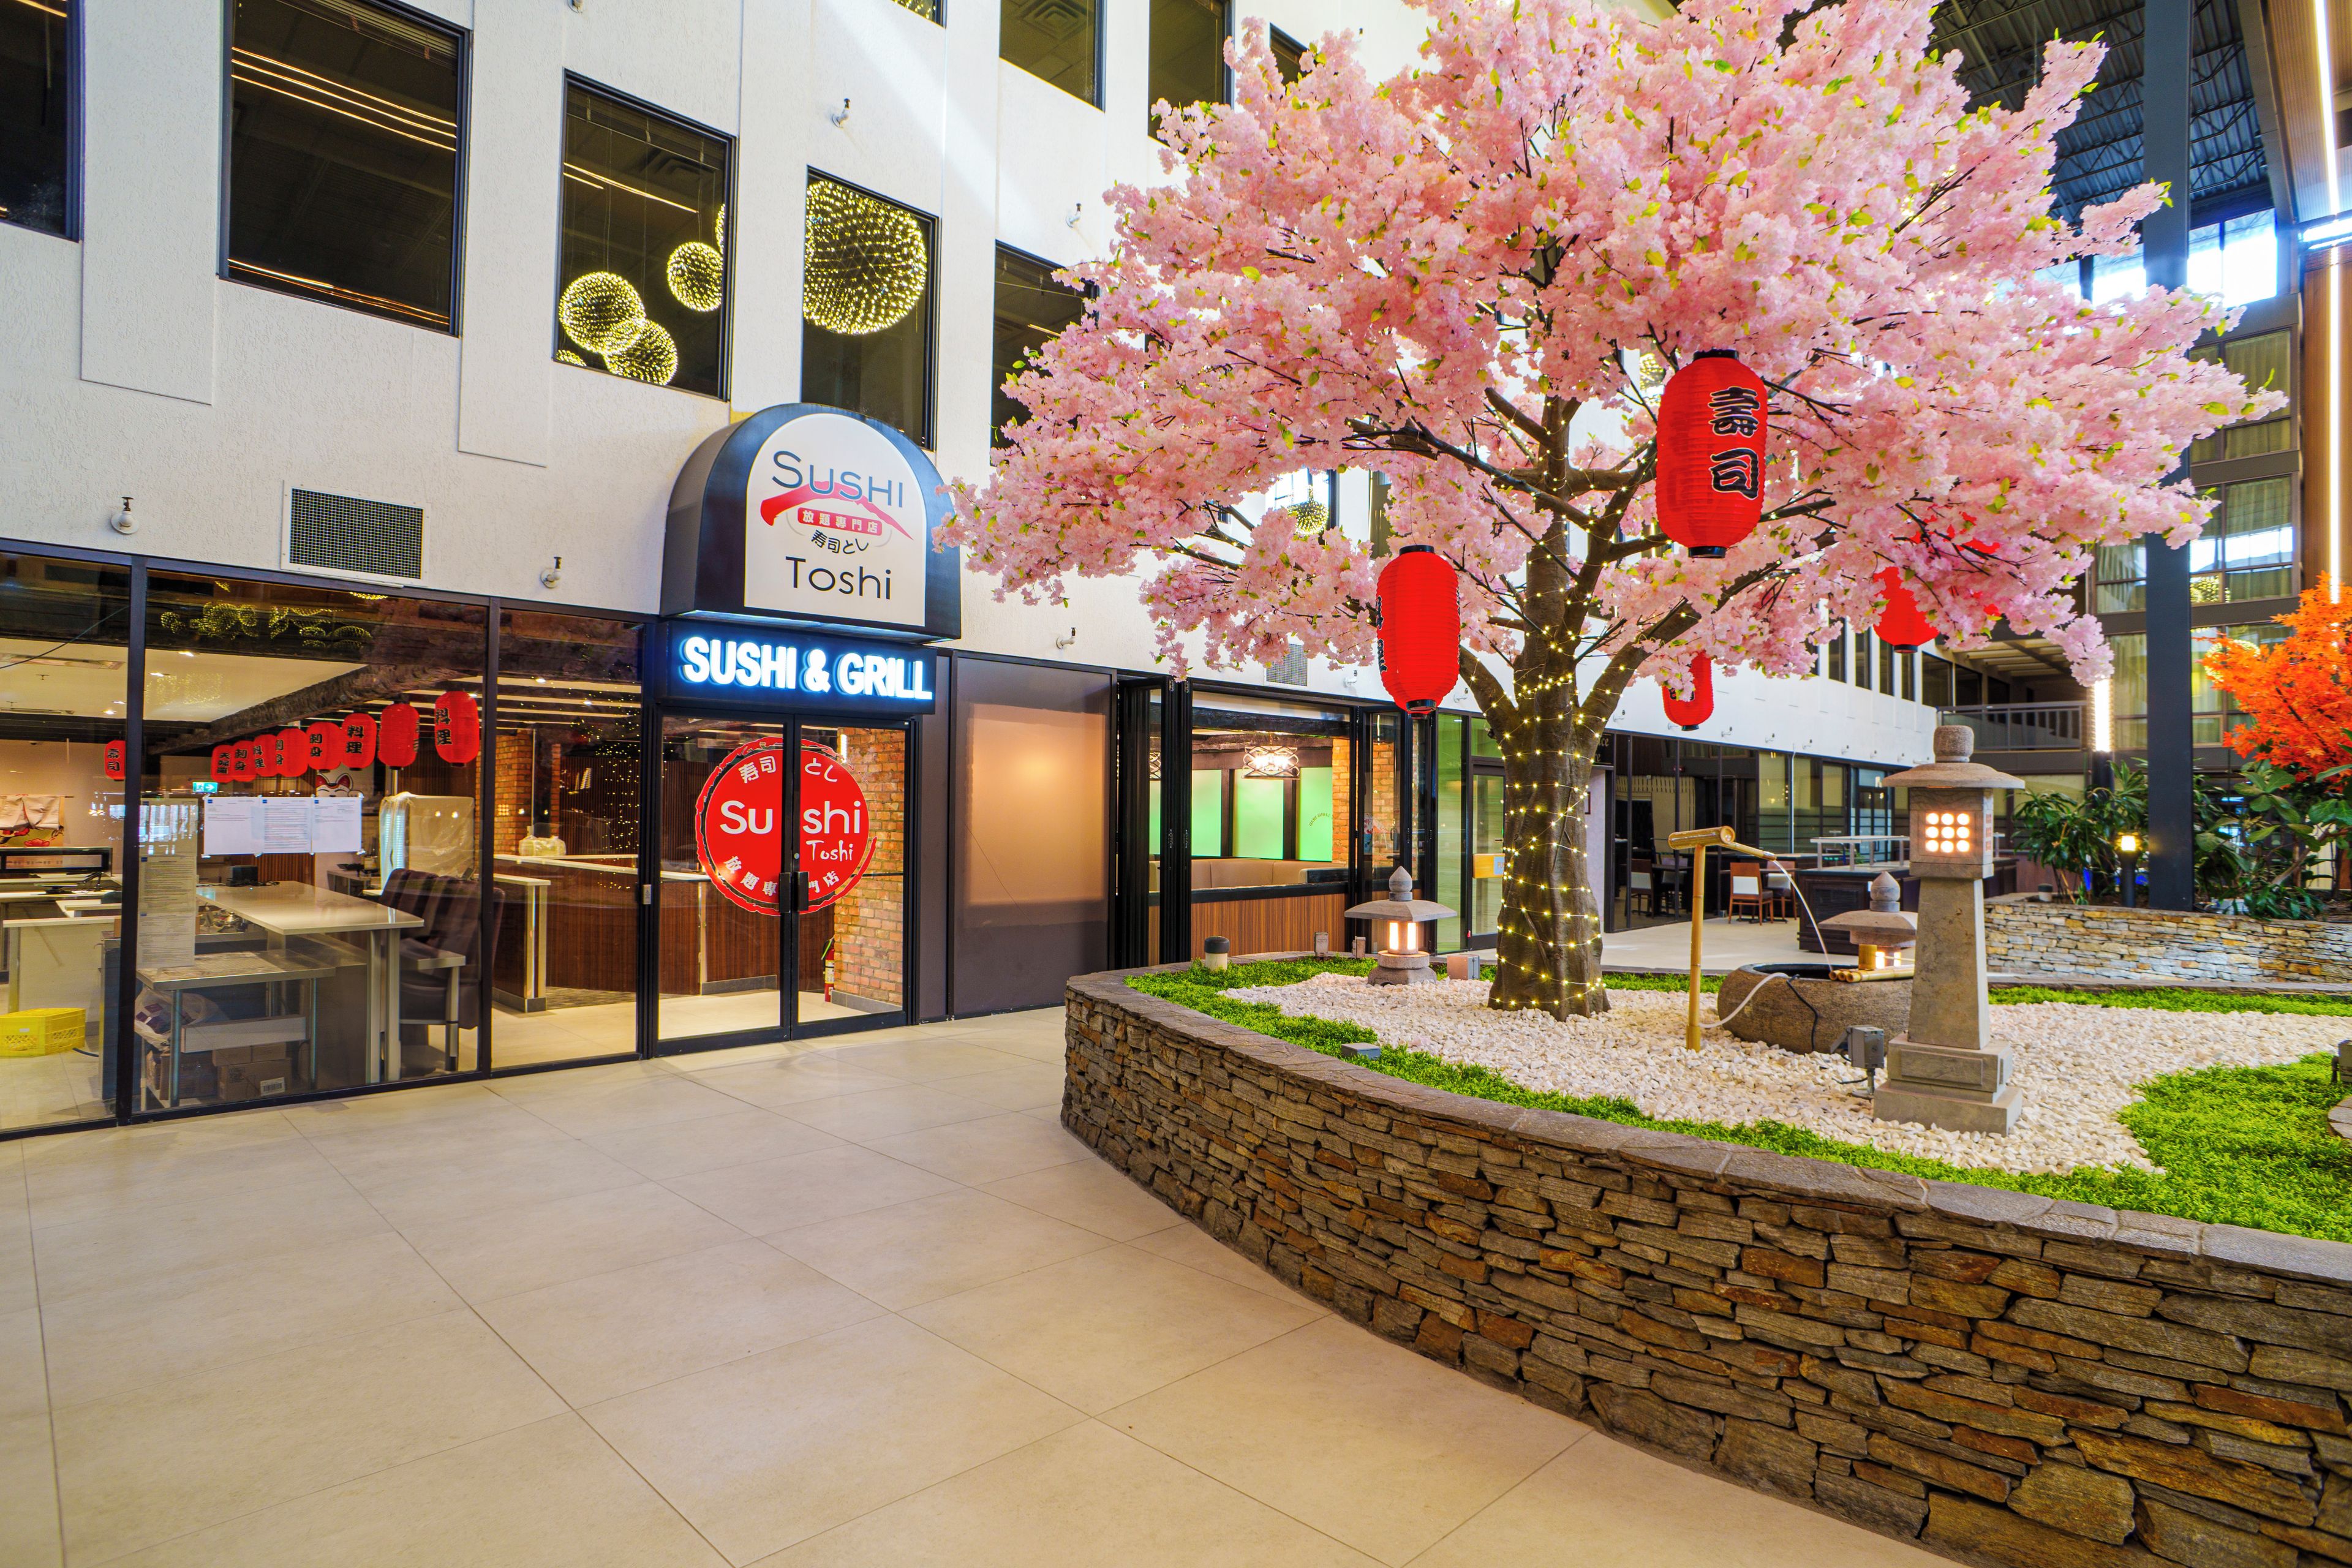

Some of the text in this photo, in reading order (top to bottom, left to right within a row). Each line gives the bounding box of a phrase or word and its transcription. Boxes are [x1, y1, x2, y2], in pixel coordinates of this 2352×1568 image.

[811, 530, 869, 554] 寿司とし
[786, 556, 891, 600] Toshi
[683, 637, 933, 700] SUSHI & GRILL
[805, 840, 853, 862] Toshi
